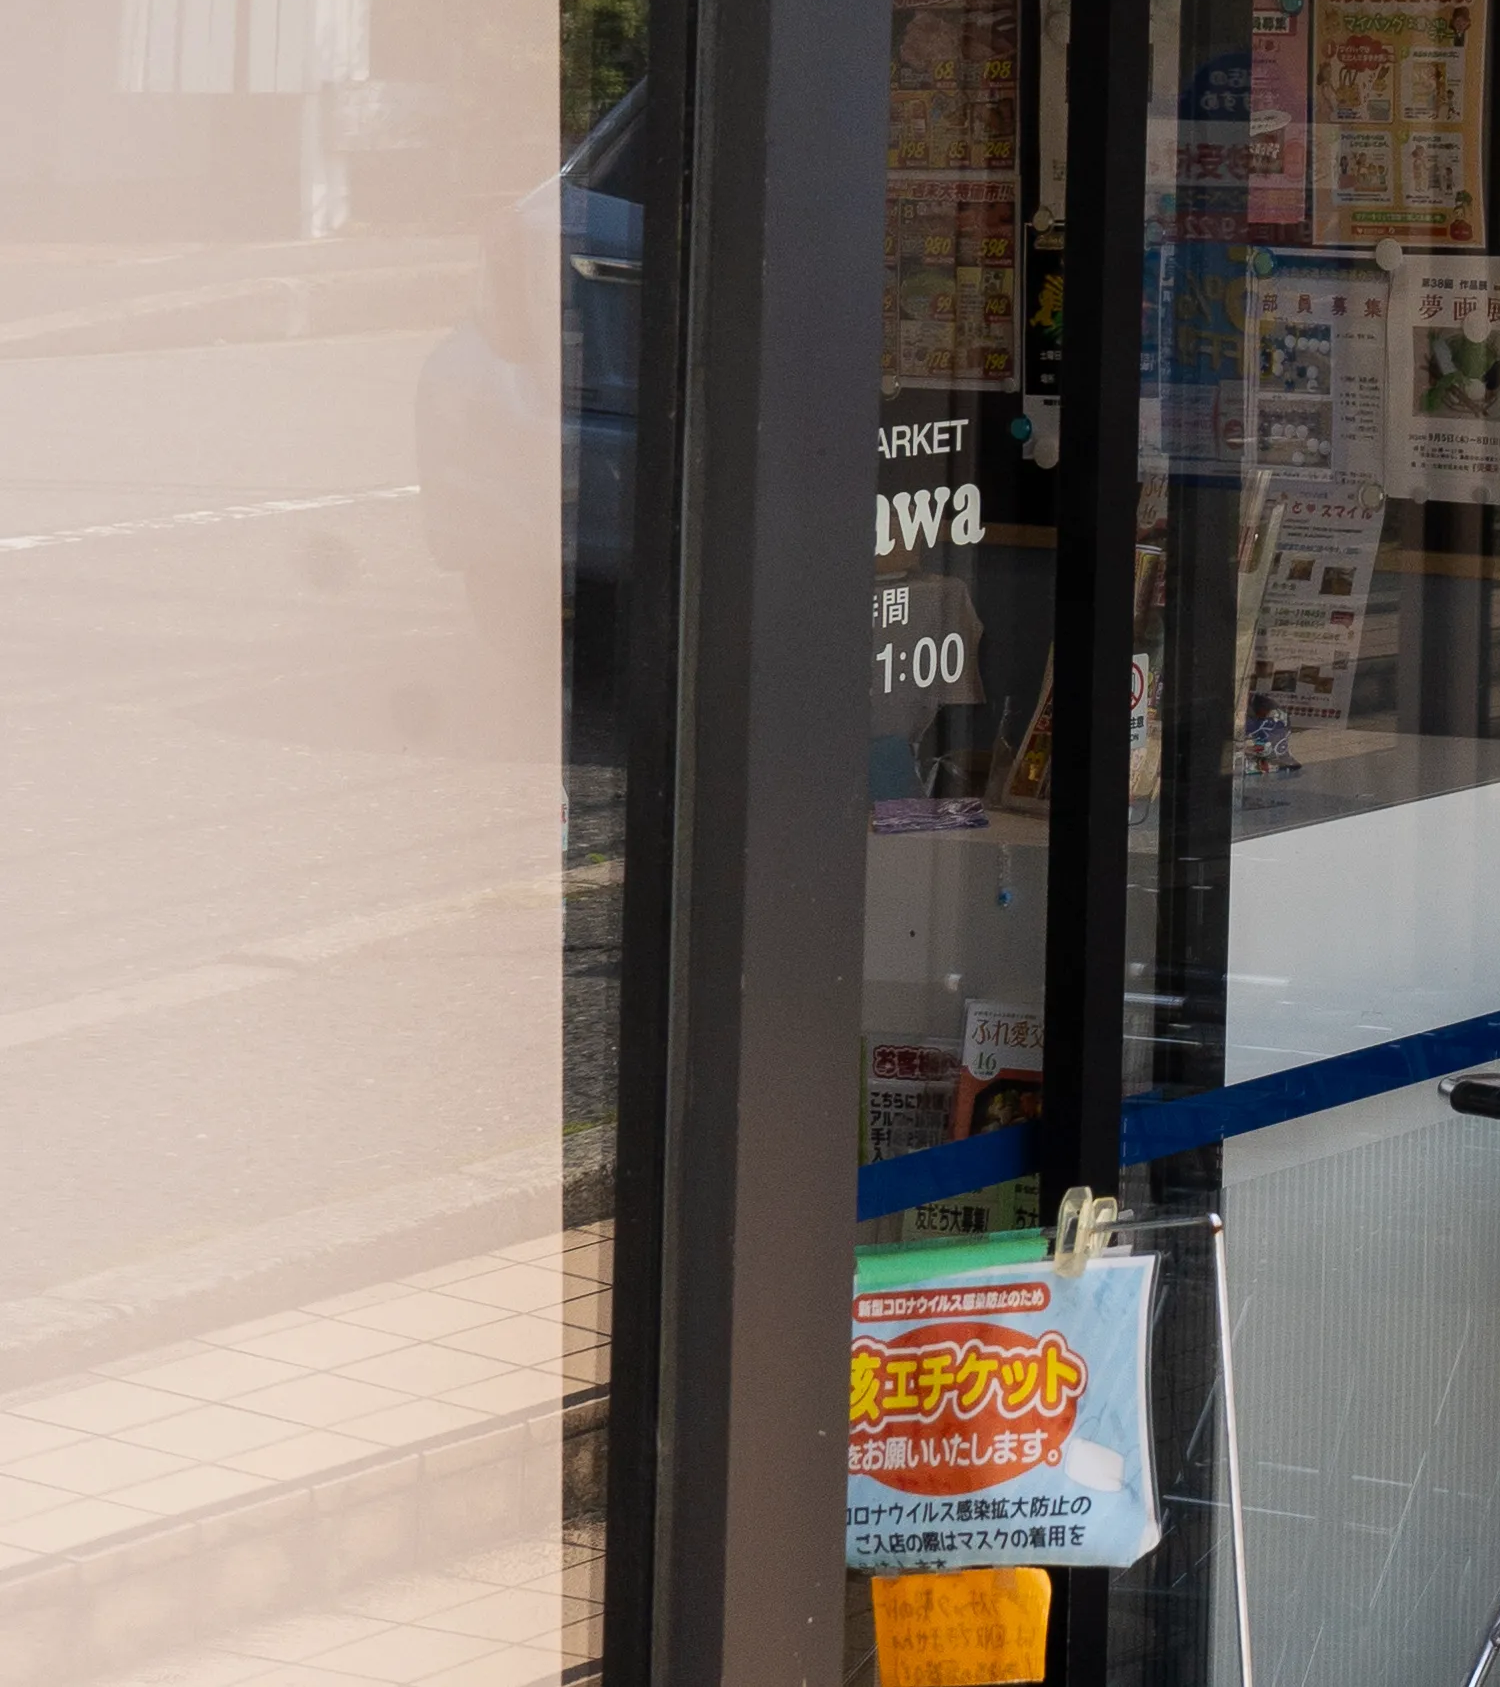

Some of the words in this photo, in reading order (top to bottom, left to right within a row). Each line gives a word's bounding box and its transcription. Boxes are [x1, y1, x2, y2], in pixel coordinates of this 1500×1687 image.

[1263, 294, 1382, 318] 部員募集
[858, 1289, 1044, 1317] 新型コロナウイルス感染防止のため
[856, 1525, 1086, 1555] ご入店の際はマスクの着用を
